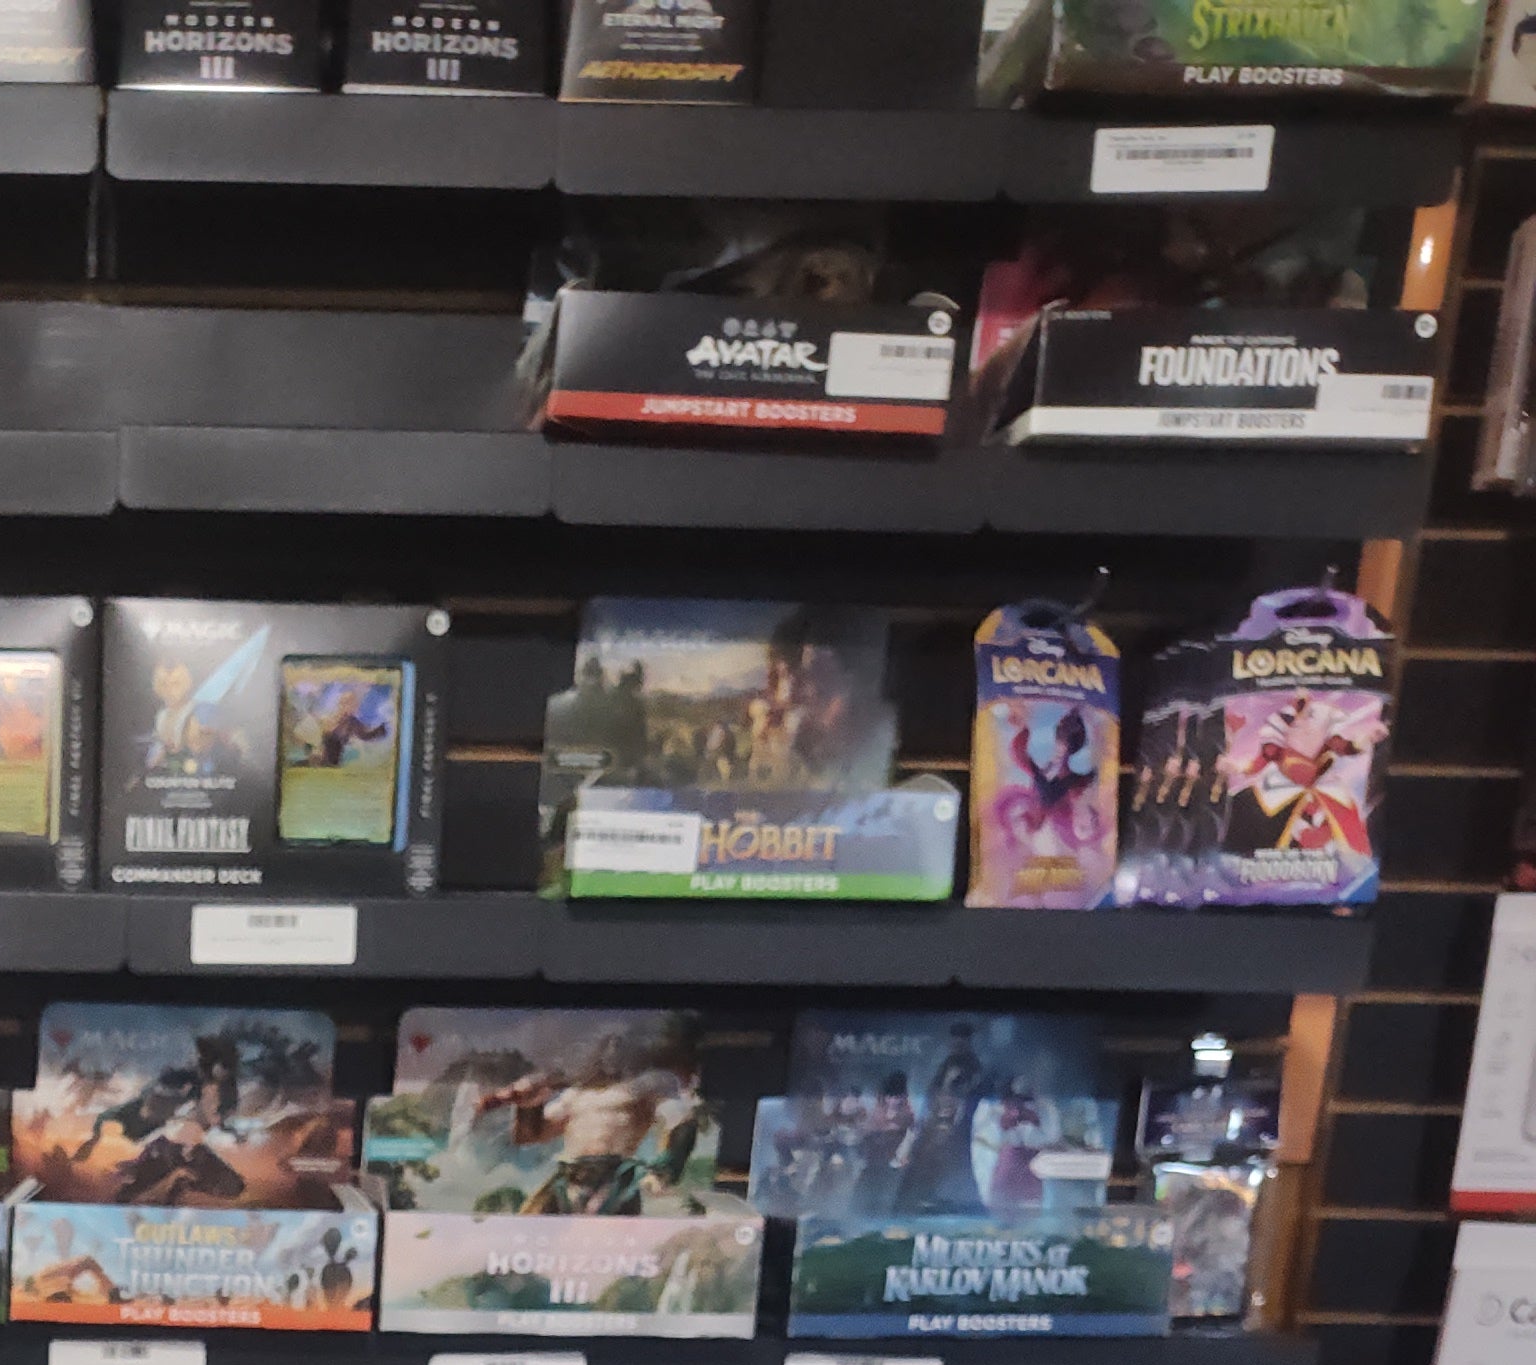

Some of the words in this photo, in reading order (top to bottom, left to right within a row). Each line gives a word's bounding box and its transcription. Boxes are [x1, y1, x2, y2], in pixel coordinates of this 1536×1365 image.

[144, 30, 294, 55] HORIZONS
[372, 31, 518, 60] HORIZONS
[200, 56, 235, 80] III
[426, 58, 461, 81] III
[1184, 66, 1233, 86] PLAY
[1238, 66, 1343, 87] BOOSTERS
[686, 335, 828, 372] AVATAR
[1138, 345, 1341, 387] FOUNDATIONS
[641, 398, 751, 419] JUMPSTART
[754, 401, 857, 424] BOOSTERS
[992, 656, 1105, 694] LORCANA
[1232, 648, 1383, 680] LORCANA
[698, 822, 843, 865] HOBBIT
[111, 866, 216, 884] COMMANDER
[218, 868, 263, 885] DECK
[690, 875, 735, 892] PLAY
[741, 875, 840, 894] BOOSTERS
[913, 1234, 1044, 1266] MURDERS
[486, 1251, 660, 1278] HORIZONS
[883, 1266, 990, 1302] KARLOV
[989, 1266, 1090, 1302] MANOR
[908, 1314, 955, 1330] PLAY
[957, 1314, 1053, 1331] BOOSTERS
